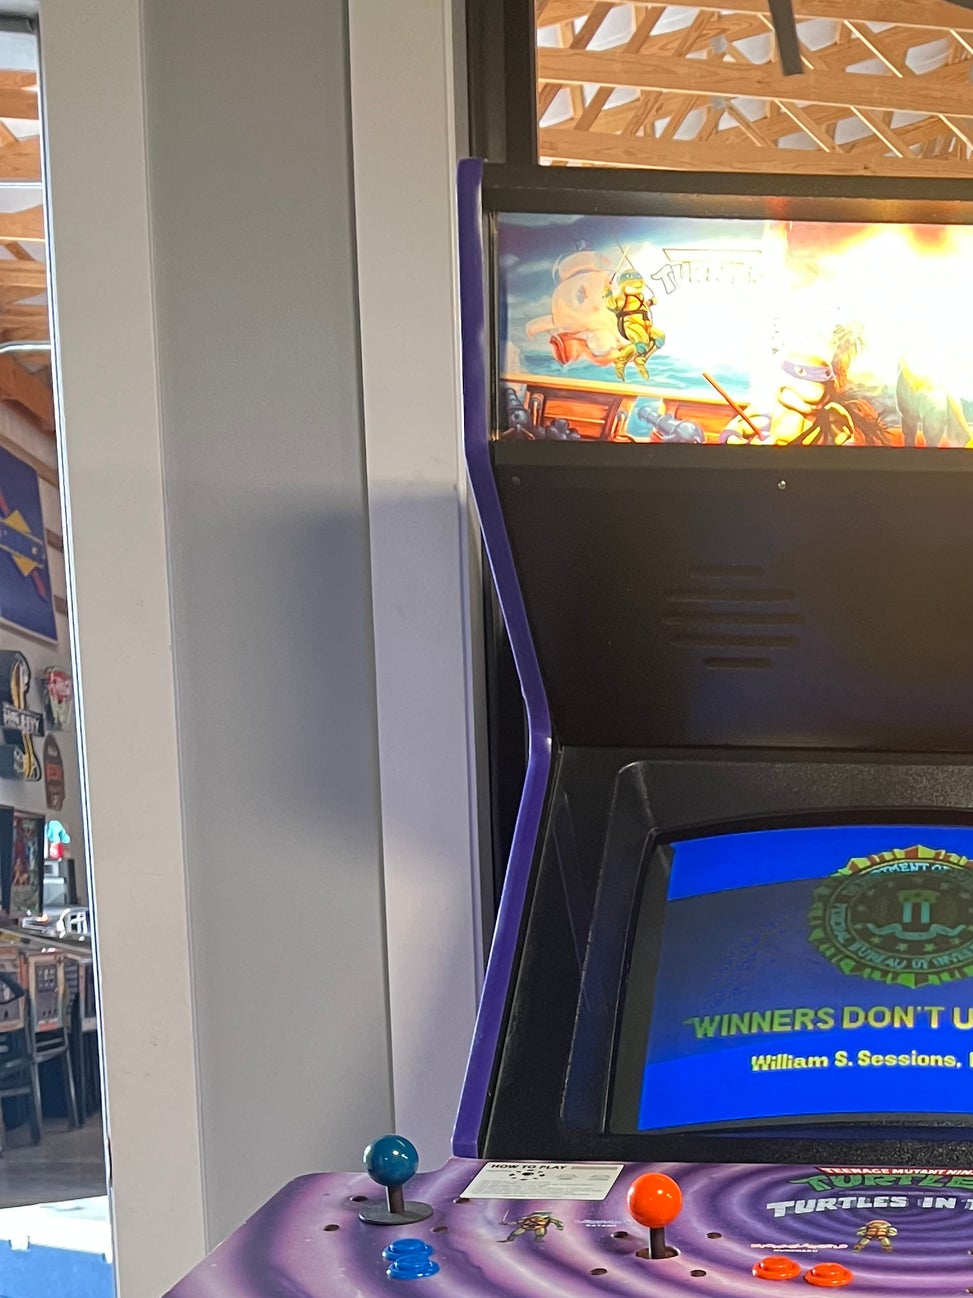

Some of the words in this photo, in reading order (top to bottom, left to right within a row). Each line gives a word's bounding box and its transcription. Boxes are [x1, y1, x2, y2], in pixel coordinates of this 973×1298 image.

[841, 1004, 945, 1030] DON'T
[751, 1051, 829, 1072] William
[834, 1050, 854, 1067] S.
[822, 1167, 891, 1175] TEENAGE
[766, 1196, 909, 1218] TURTLES
[920, 1196, 958, 1210] IN
